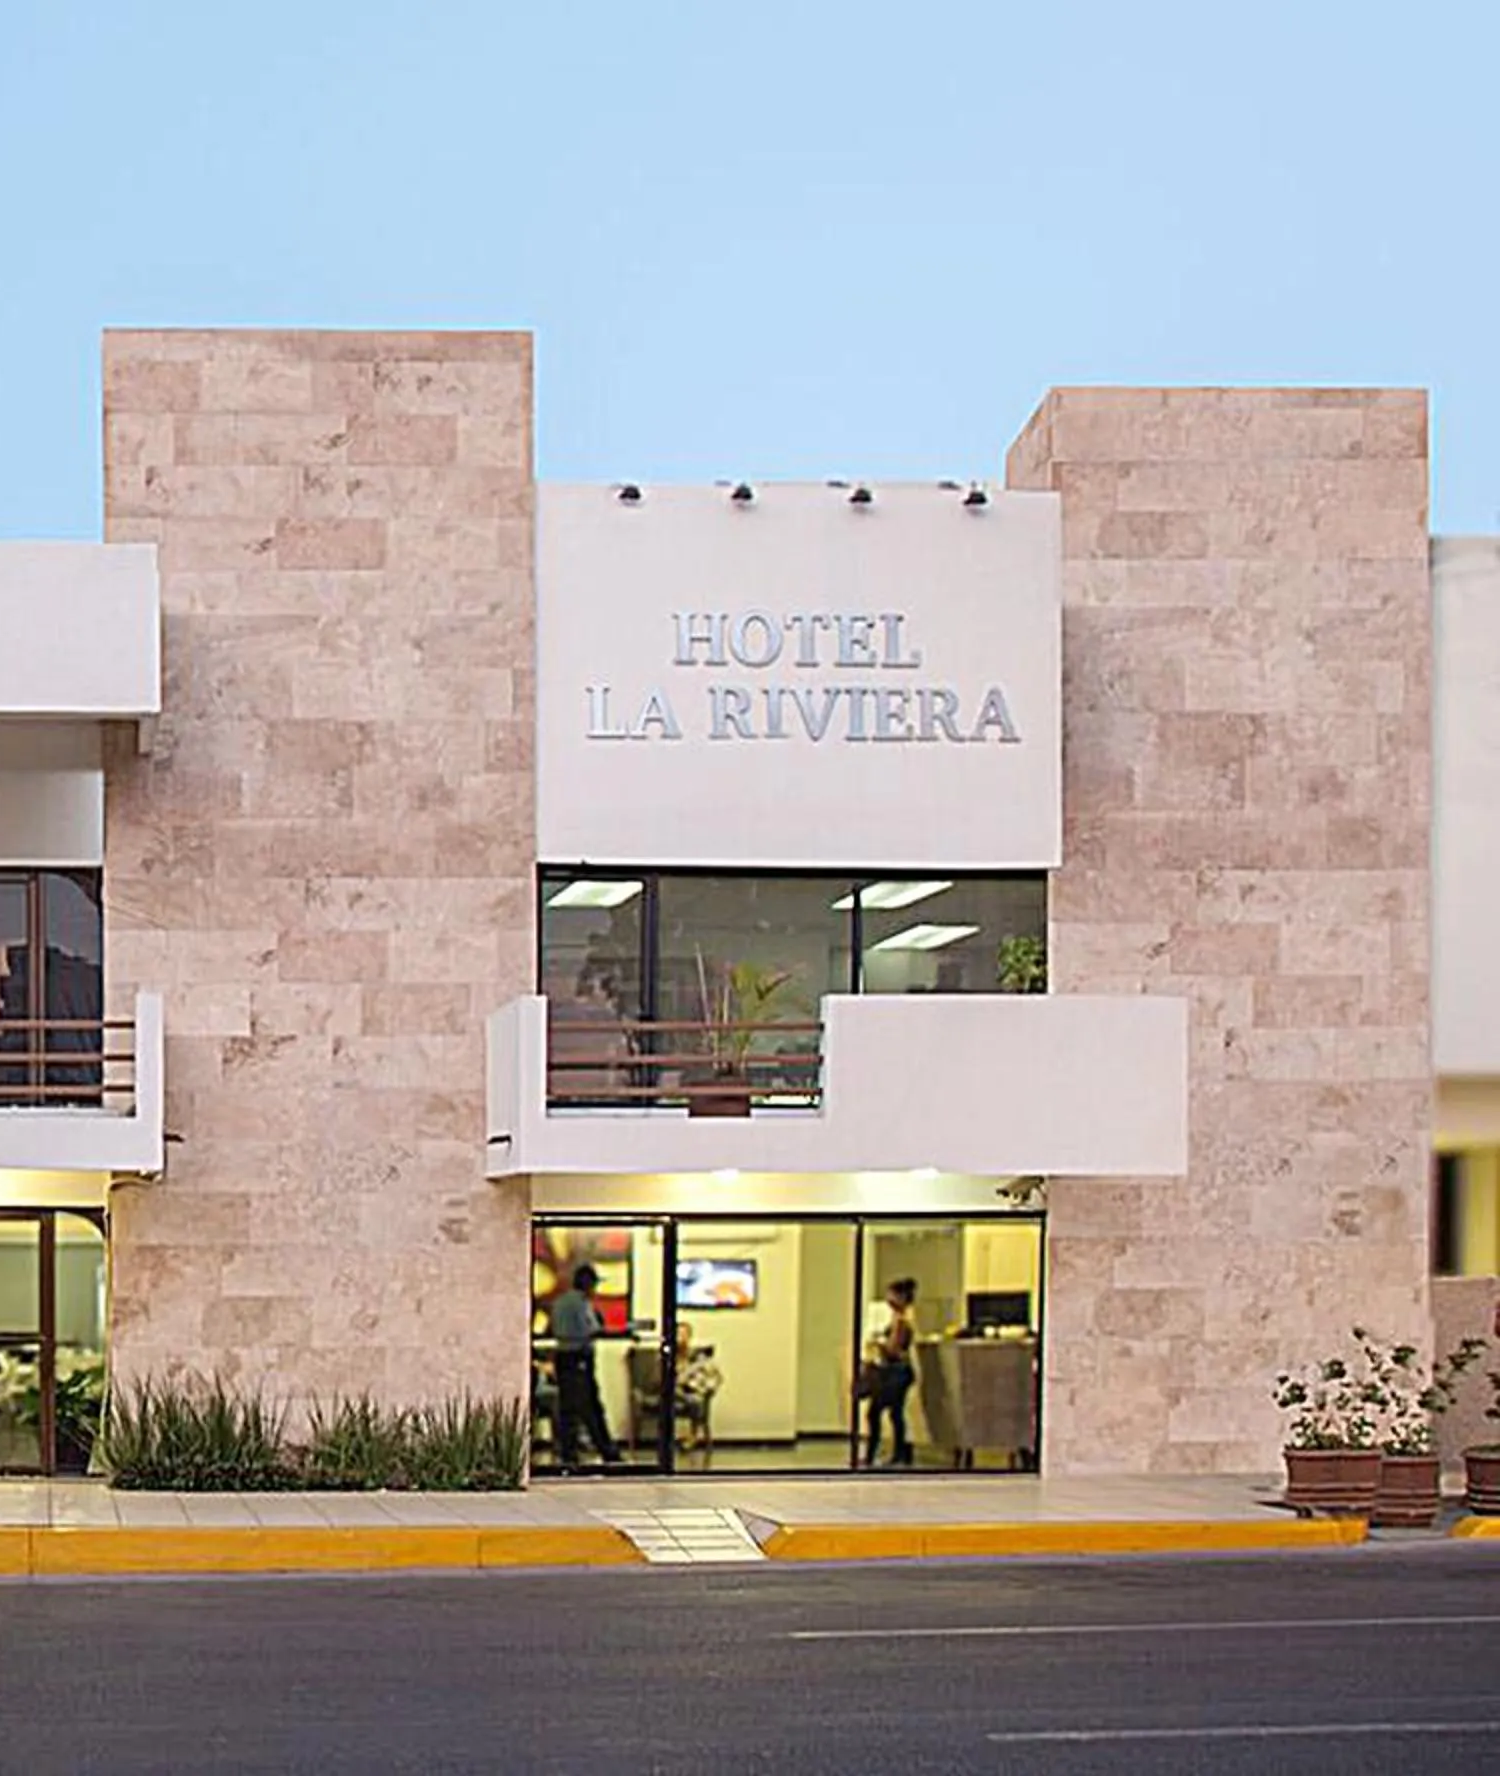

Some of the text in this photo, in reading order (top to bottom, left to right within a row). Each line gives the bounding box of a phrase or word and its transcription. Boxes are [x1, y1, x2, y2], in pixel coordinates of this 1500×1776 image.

[673, 609, 921, 669] HOTEL
[585, 682, 1022, 743] LA RIVIERA
